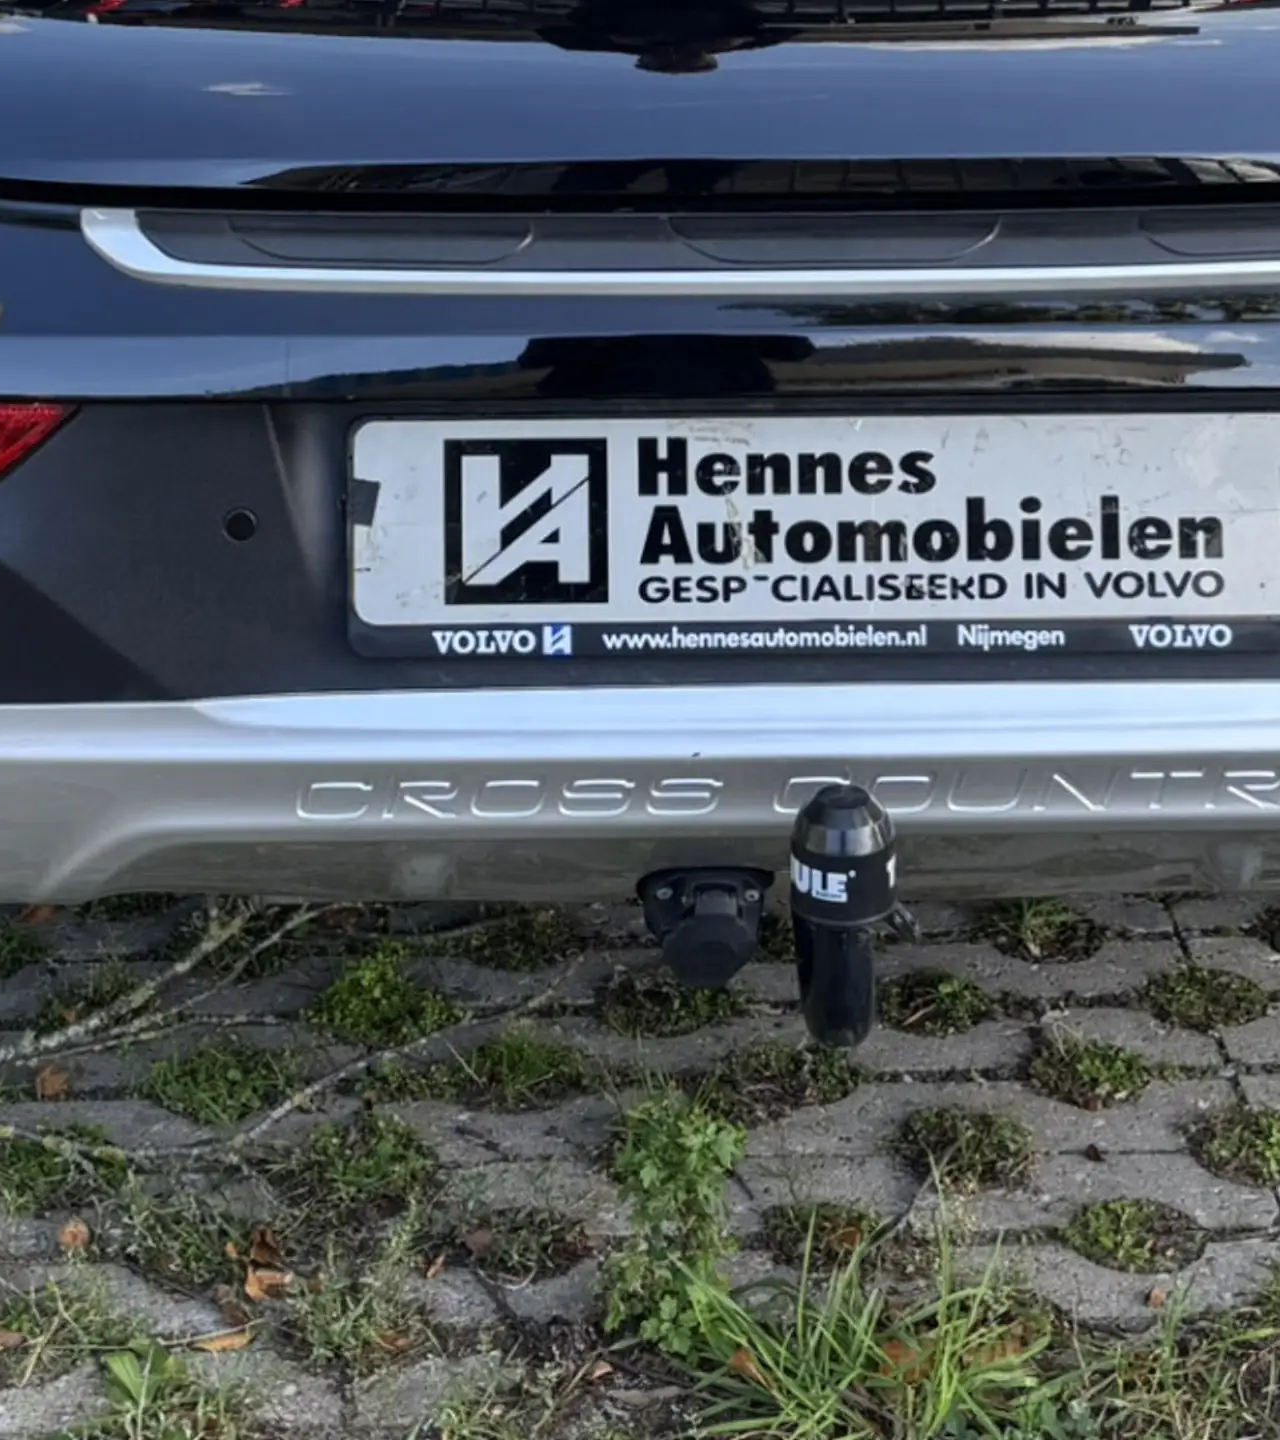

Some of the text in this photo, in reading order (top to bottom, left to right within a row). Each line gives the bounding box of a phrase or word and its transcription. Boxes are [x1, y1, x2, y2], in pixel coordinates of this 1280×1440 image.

[638, 436, 936, 496] Hennes
[639, 495, 1224, 565] Automobielen
[638, 570, 1224, 603] GESPCIALISEERD IN VOLVO
[432, 629, 537, 654] VOLVO
[602, 624, 927, 650] www.hennesautomobielen.nl
[957, 624, 1066, 651] Nijmegen
[1128, 623, 1233, 648] VOLVO
[296, 777, 724, 819] CROSS
[791, 855, 848, 902] ULE
